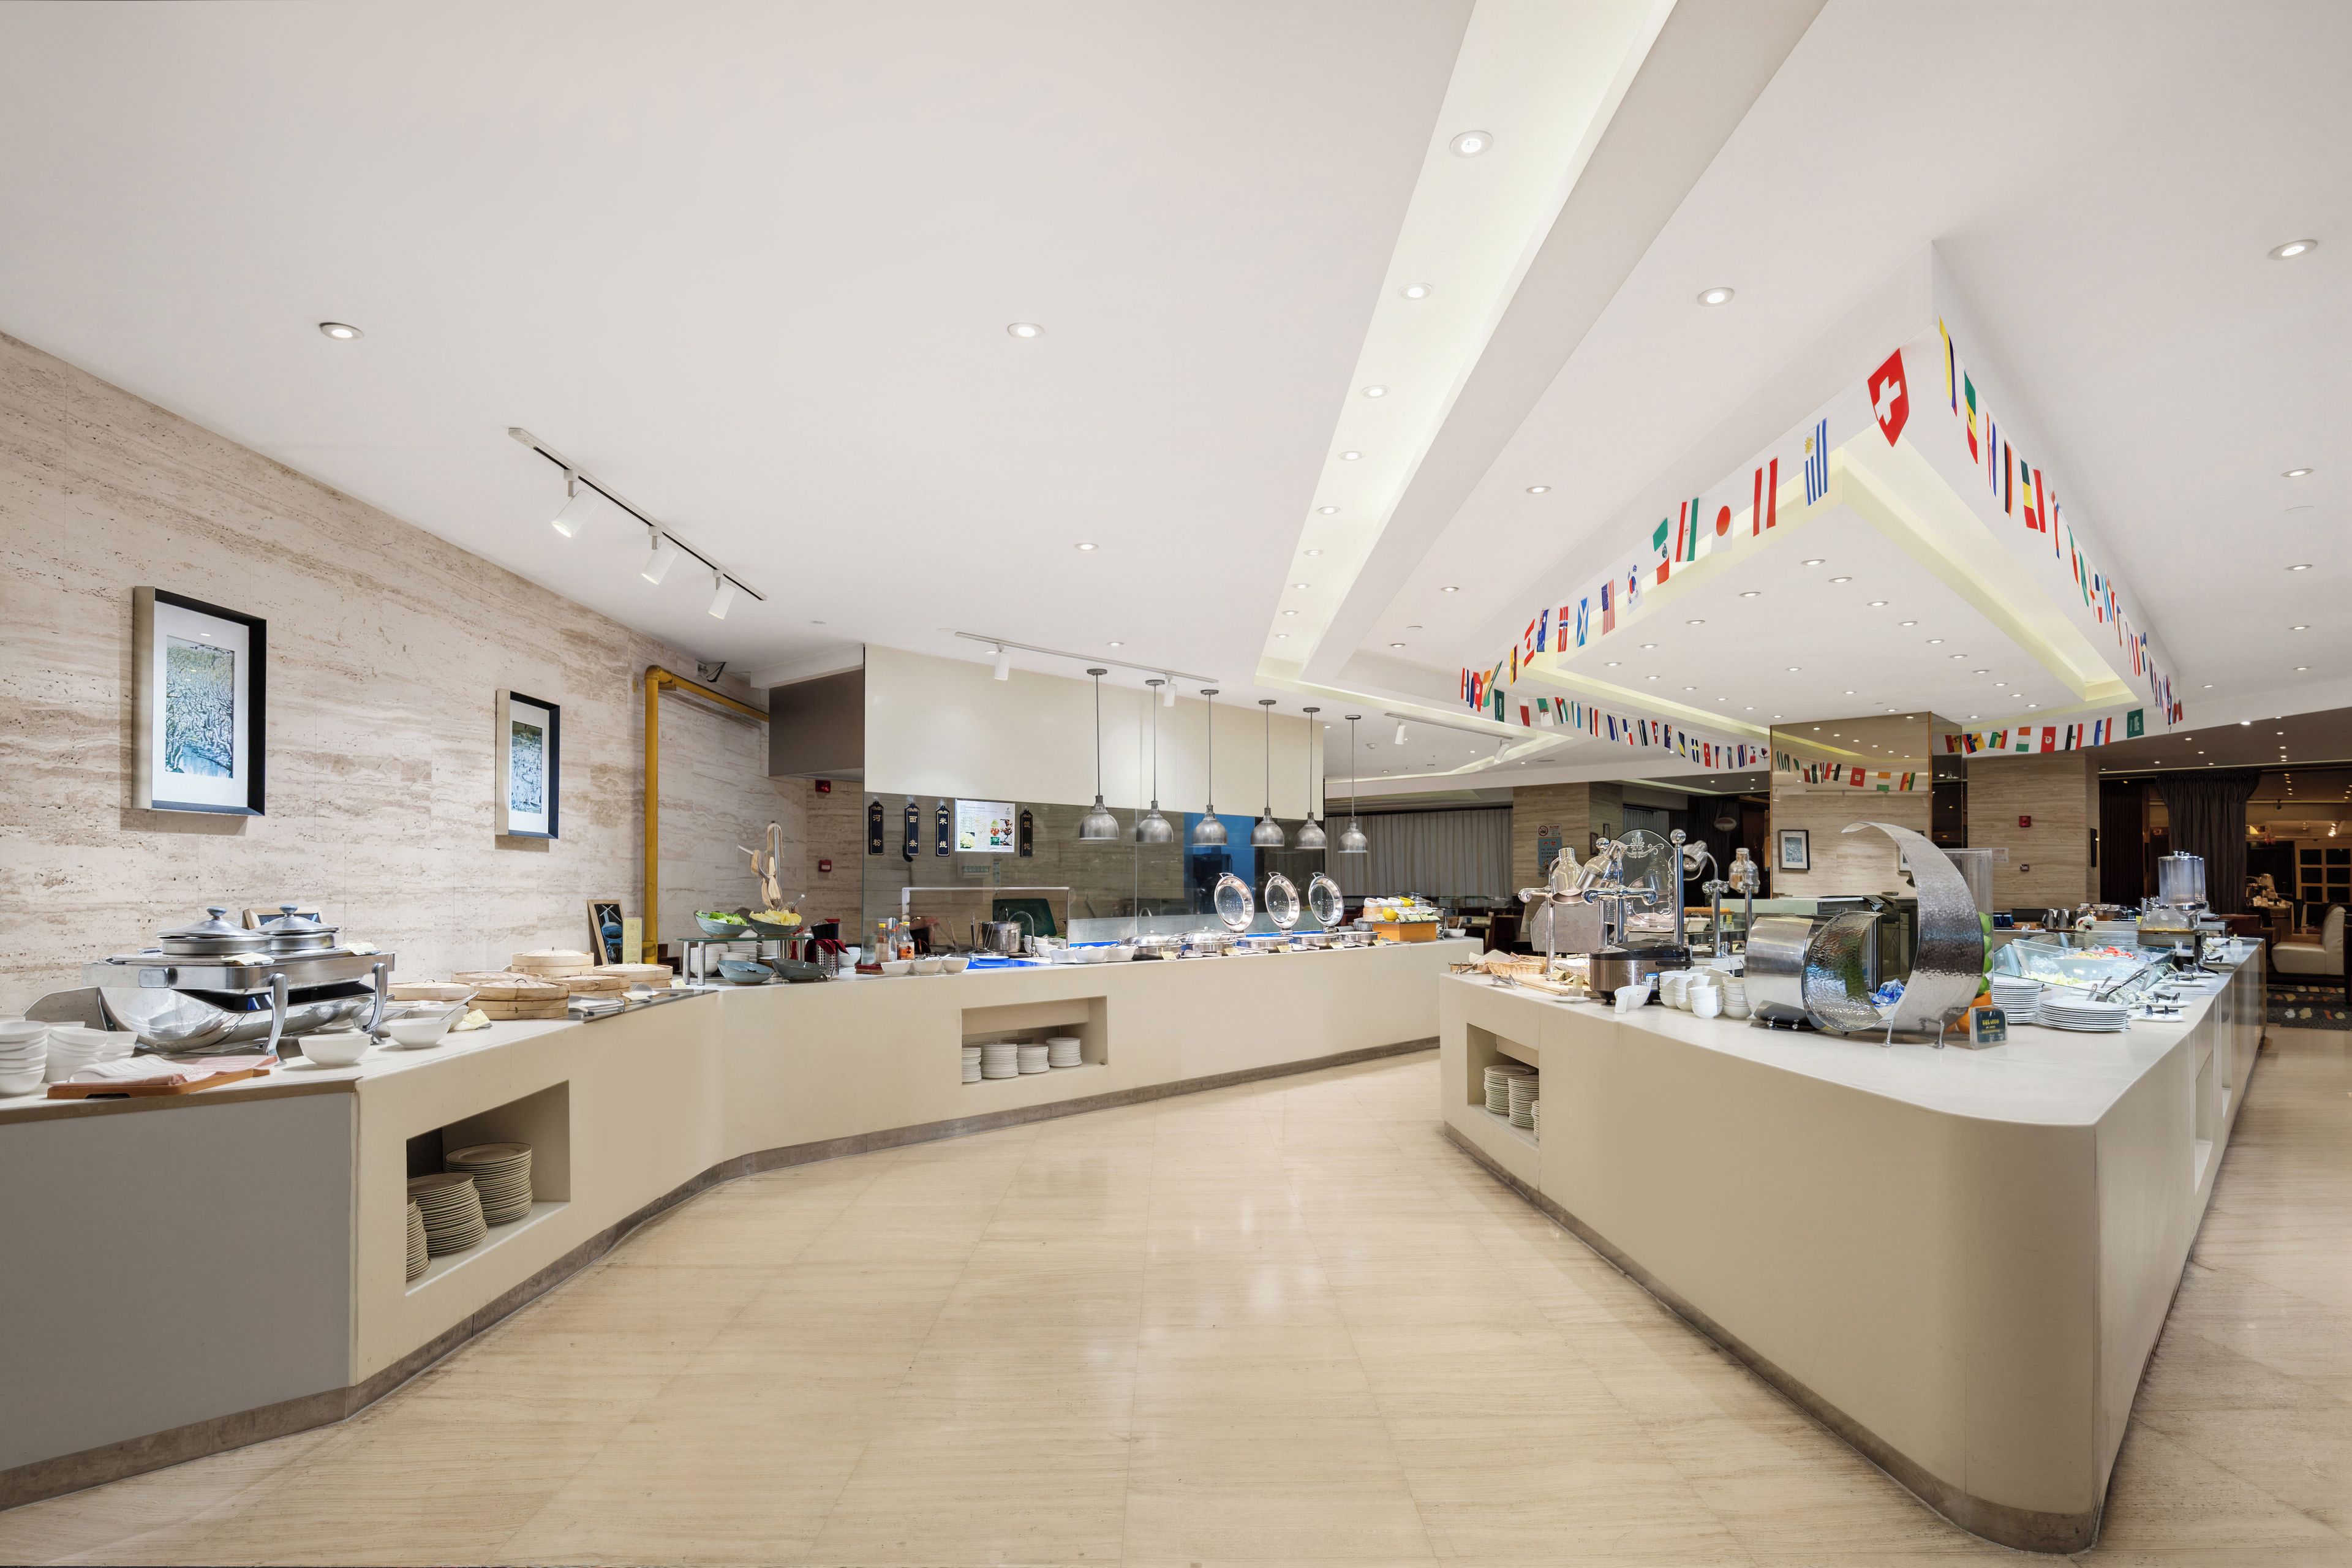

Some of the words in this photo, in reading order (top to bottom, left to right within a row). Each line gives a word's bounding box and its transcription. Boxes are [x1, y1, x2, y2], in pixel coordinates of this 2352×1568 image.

[872, 814, 881, 846] 河粉
[908, 815, 918, 847] 面条
[939, 818, 948, 848] 米线
